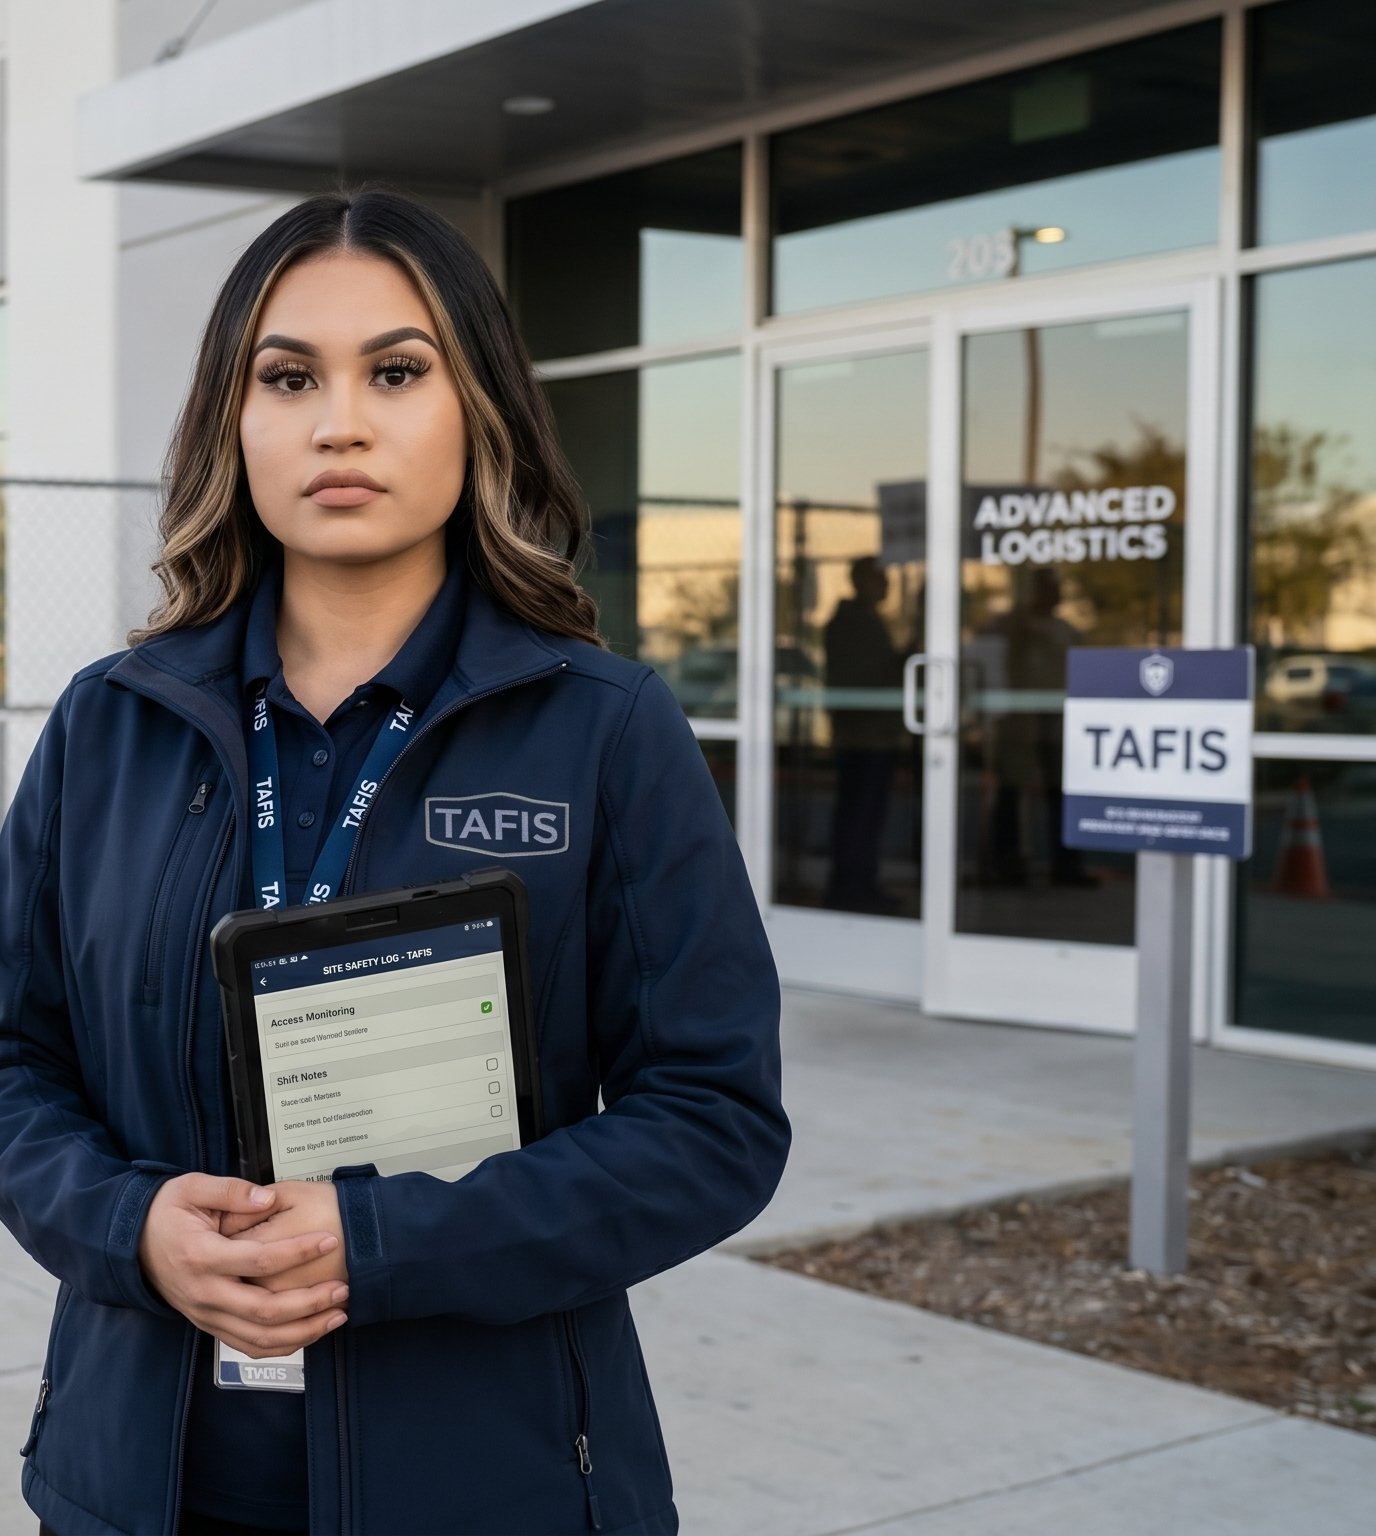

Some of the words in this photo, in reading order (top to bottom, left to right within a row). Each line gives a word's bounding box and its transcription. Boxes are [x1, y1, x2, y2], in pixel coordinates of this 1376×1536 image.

[972, 486, 1176, 527] ADVANCED
[981, 523, 1169, 565] LOGISTICS
[1084, 727, 1229, 774] TAFIS
[256, 776, 275, 829] TAFIS
[341, 778, 378, 829] TAFIS
[434, 808, 559, 845] TAFIS
[323, 963, 344, 976] SITE
[345, 958, 379, 972] SAFETY
[381, 953, 400, 966] LOG
[406, 948, 433, 961] TAFIS
[271, 1015, 304, 1028] Access
[306, 1006, 355, 1022] Monitoring
[277, 1074, 299, 1086] Shift
[301, 1070, 328, 1082] Notes
